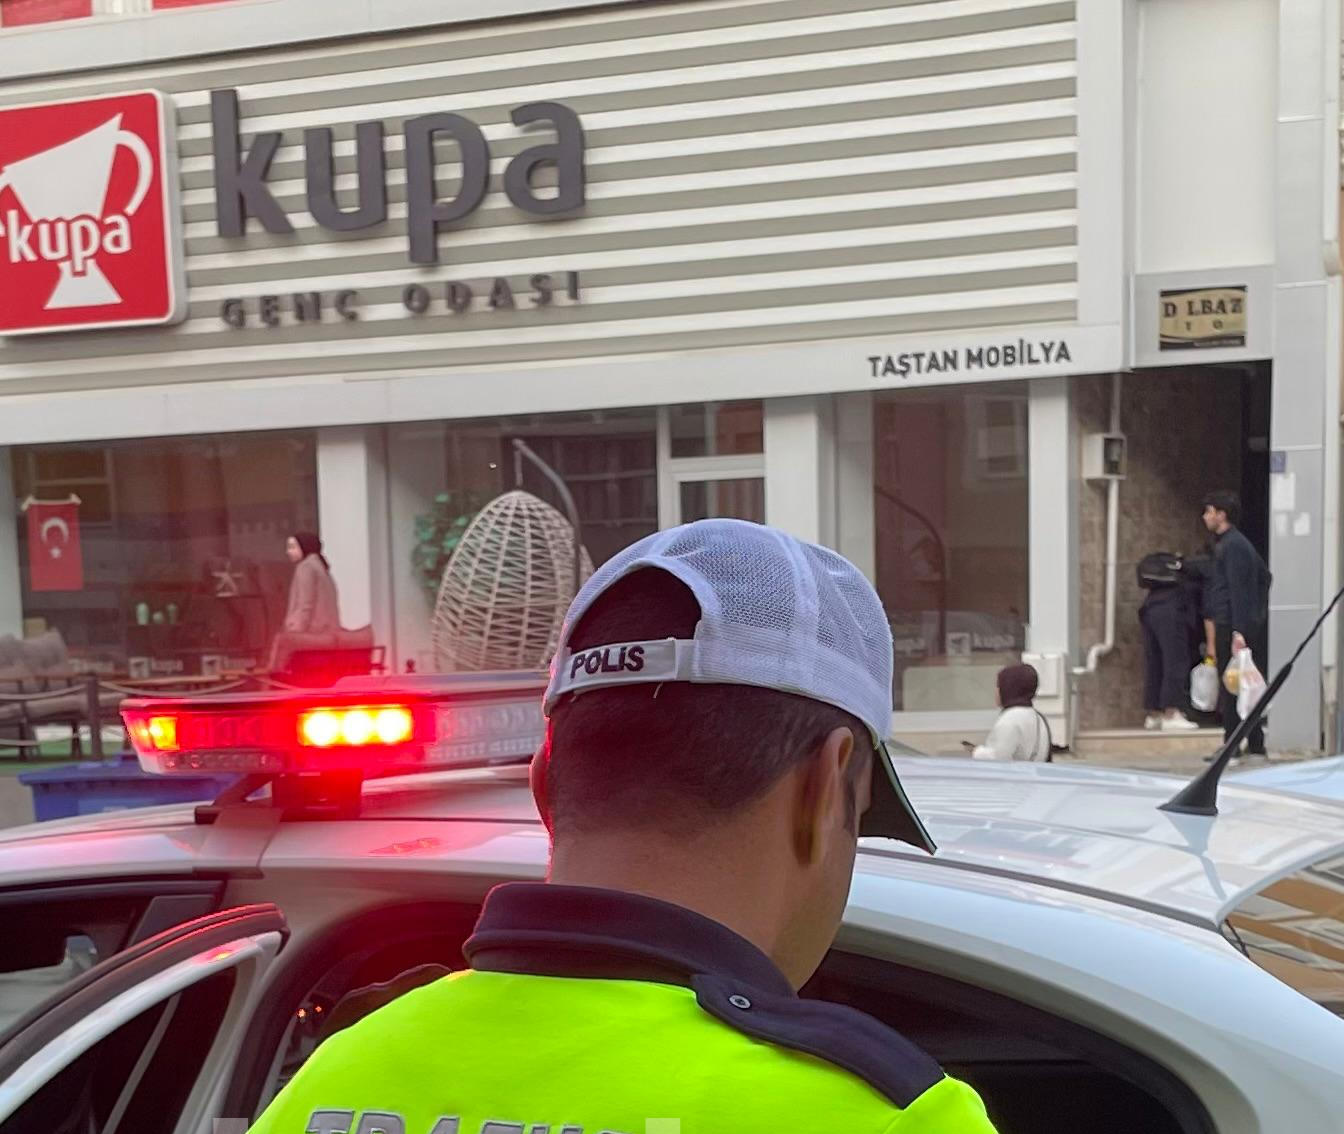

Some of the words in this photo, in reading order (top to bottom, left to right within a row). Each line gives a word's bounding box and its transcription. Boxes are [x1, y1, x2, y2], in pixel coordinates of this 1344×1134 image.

[209, 88, 586, 264] kupa
[7, 214, 132, 278] kupa
[222, 290, 361, 329] GENÇ
[403, 271, 584, 314] ODASI
[868, 351, 957, 378] TAŞTAN
[966, 339, 1072, 370] MOBİLYA
